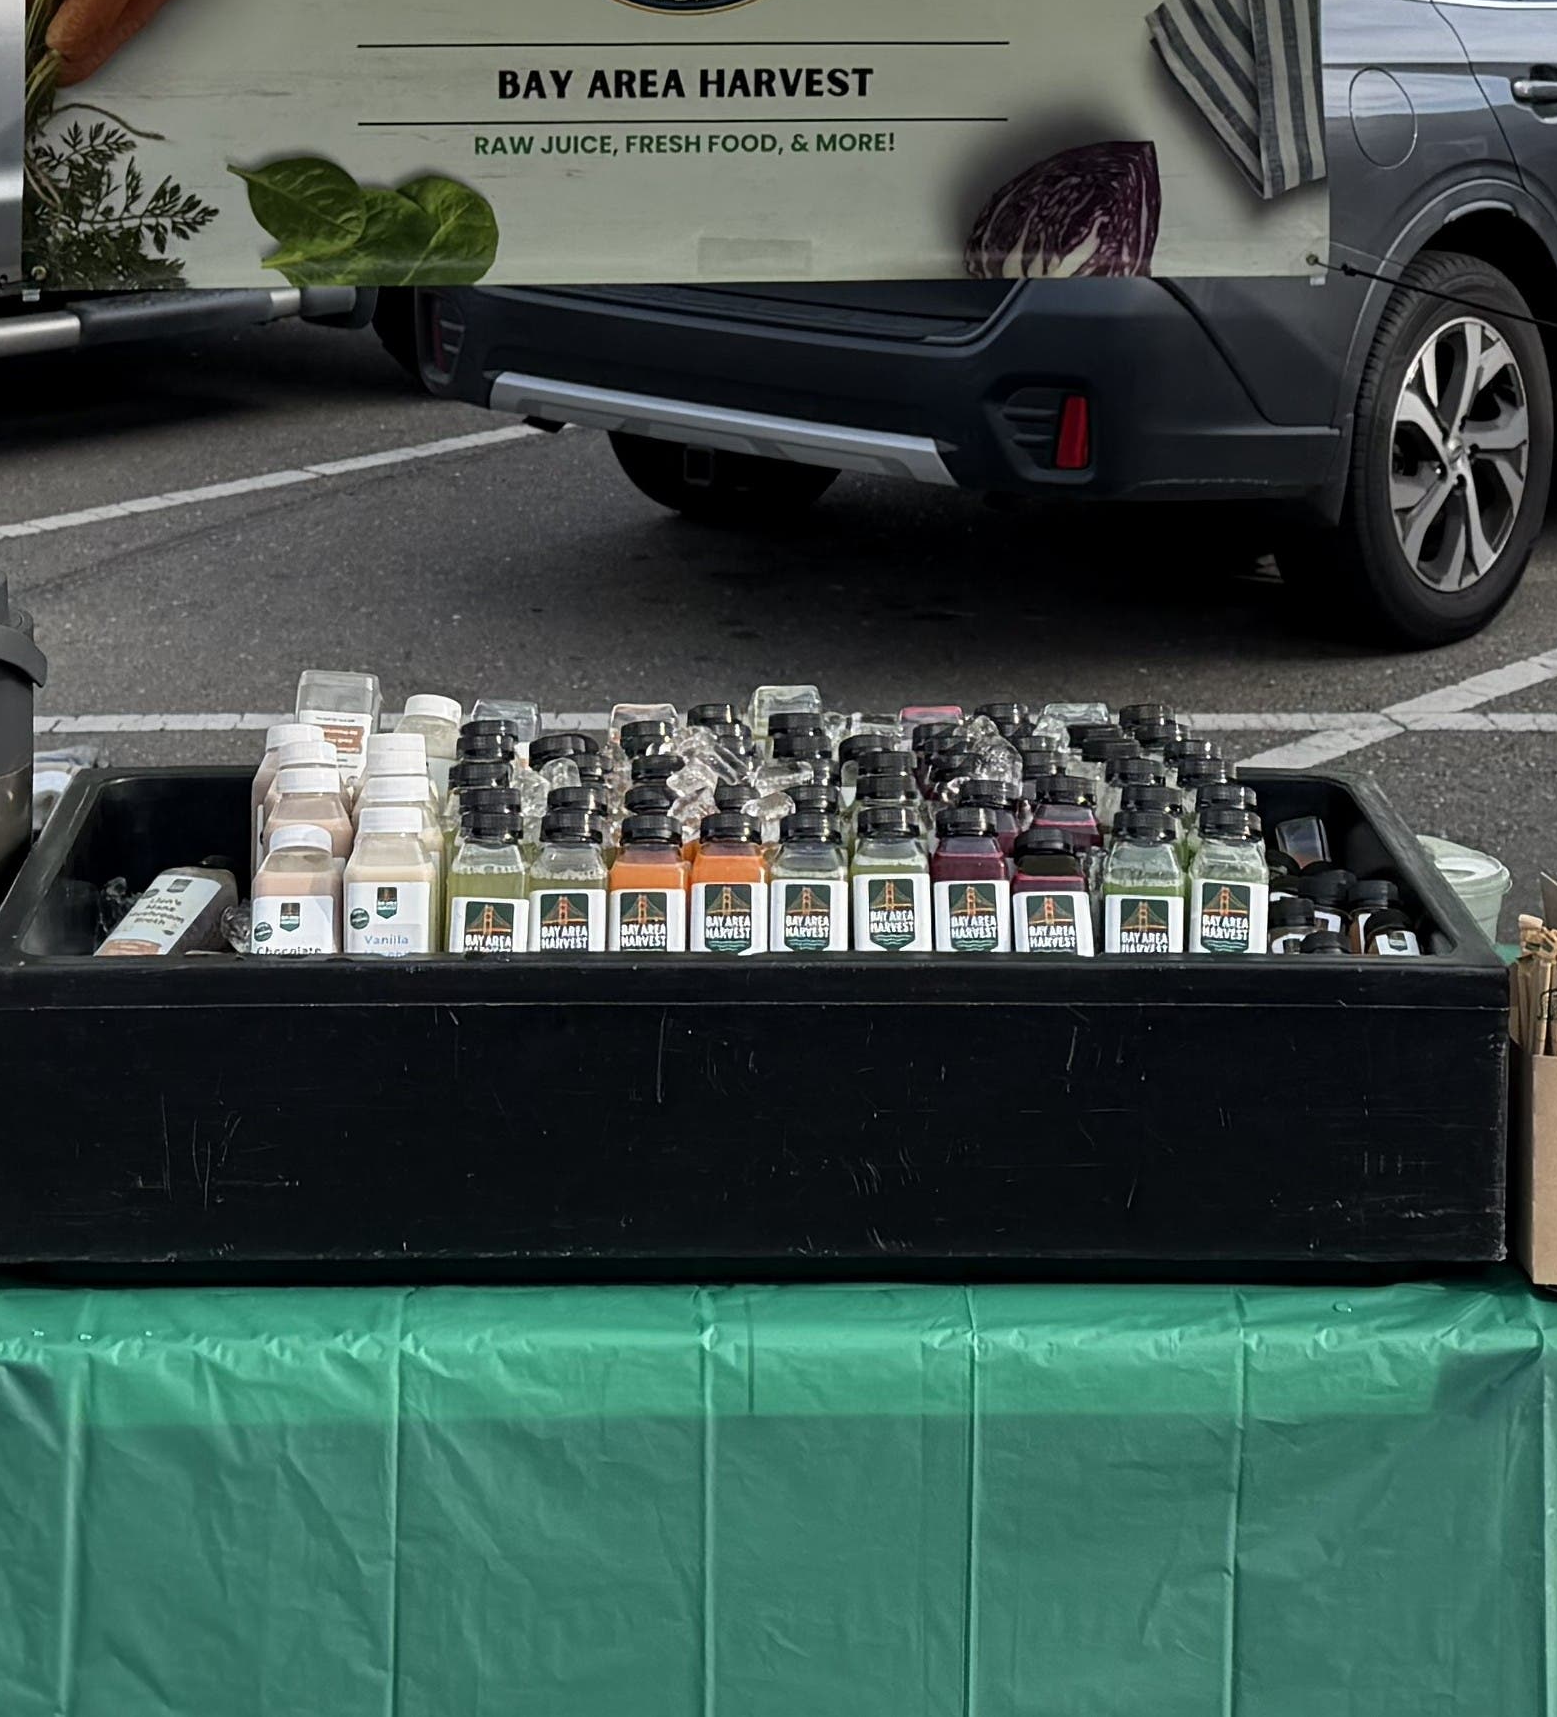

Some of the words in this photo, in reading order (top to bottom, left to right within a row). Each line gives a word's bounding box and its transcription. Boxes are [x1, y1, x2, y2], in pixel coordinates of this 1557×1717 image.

[497, 69, 574, 101] BAY
[587, 69, 685, 98] AREA
[699, 68, 873, 97] HARVEST
[474, 136, 534, 156] RAW
[540, 135, 618, 158] JUICE,
[626, 134, 701, 154] FRESH
[709, 134, 784, 156] FOOD,
[791, 134, 810, 153] &
[816, 132, 896, 153] MORE!
[786, 916, 804, 926] BAY
[804, 916, 829, 927] AREA
[786, 927, 828, 937] HARVEST
[365, 935, 409, 945] Vanilla
